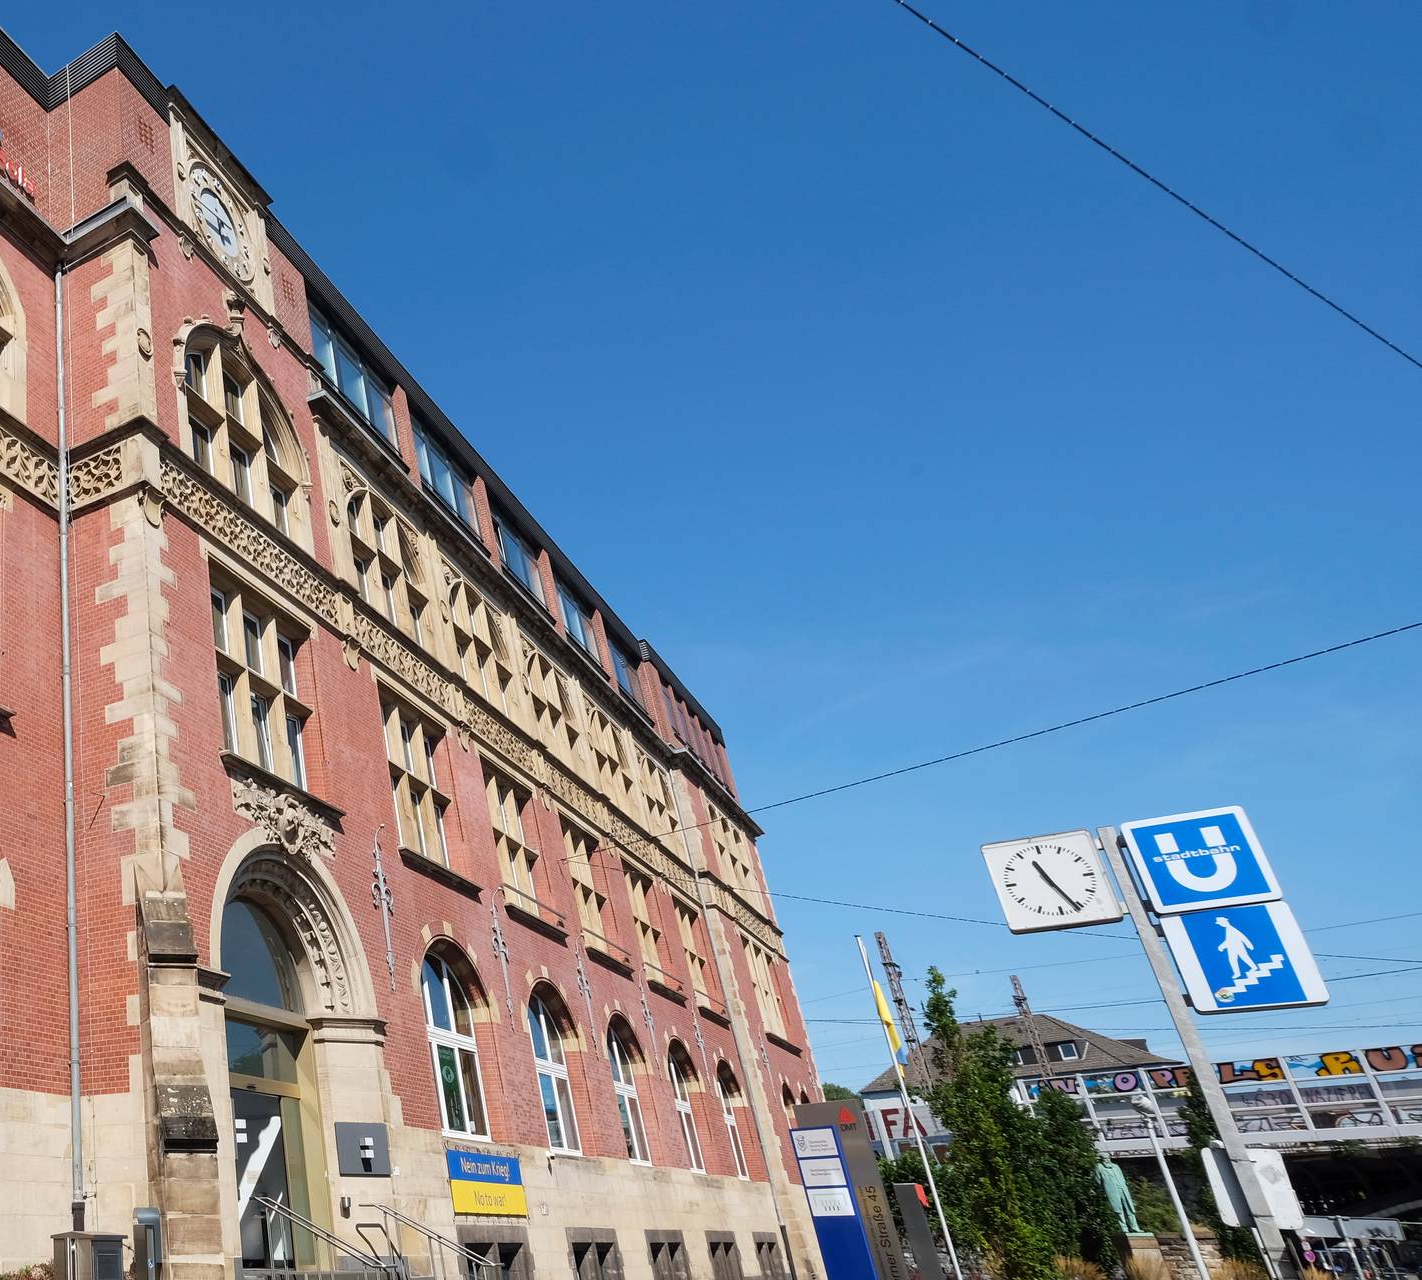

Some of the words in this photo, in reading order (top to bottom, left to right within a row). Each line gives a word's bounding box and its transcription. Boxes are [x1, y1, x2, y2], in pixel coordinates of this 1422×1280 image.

[1152, 844, 1242, 863] stadtbahn
[1315, 1044, 1422, 1077] RU
[840, 1123, 857, 1132] DMT
[460, 1156, 477, 1173] Nein
[477, 1162, 492, 1175] zum
[490, 1159, 510, 1182] Krieg!
[473, 1189, 485, 1206] No
[484, 1193, 493, 1207] to
[493, 1192, 507, 1207] war!
[864, 1185, 877, 1202] 45
[872, 1205, 891, 1249] Straße
